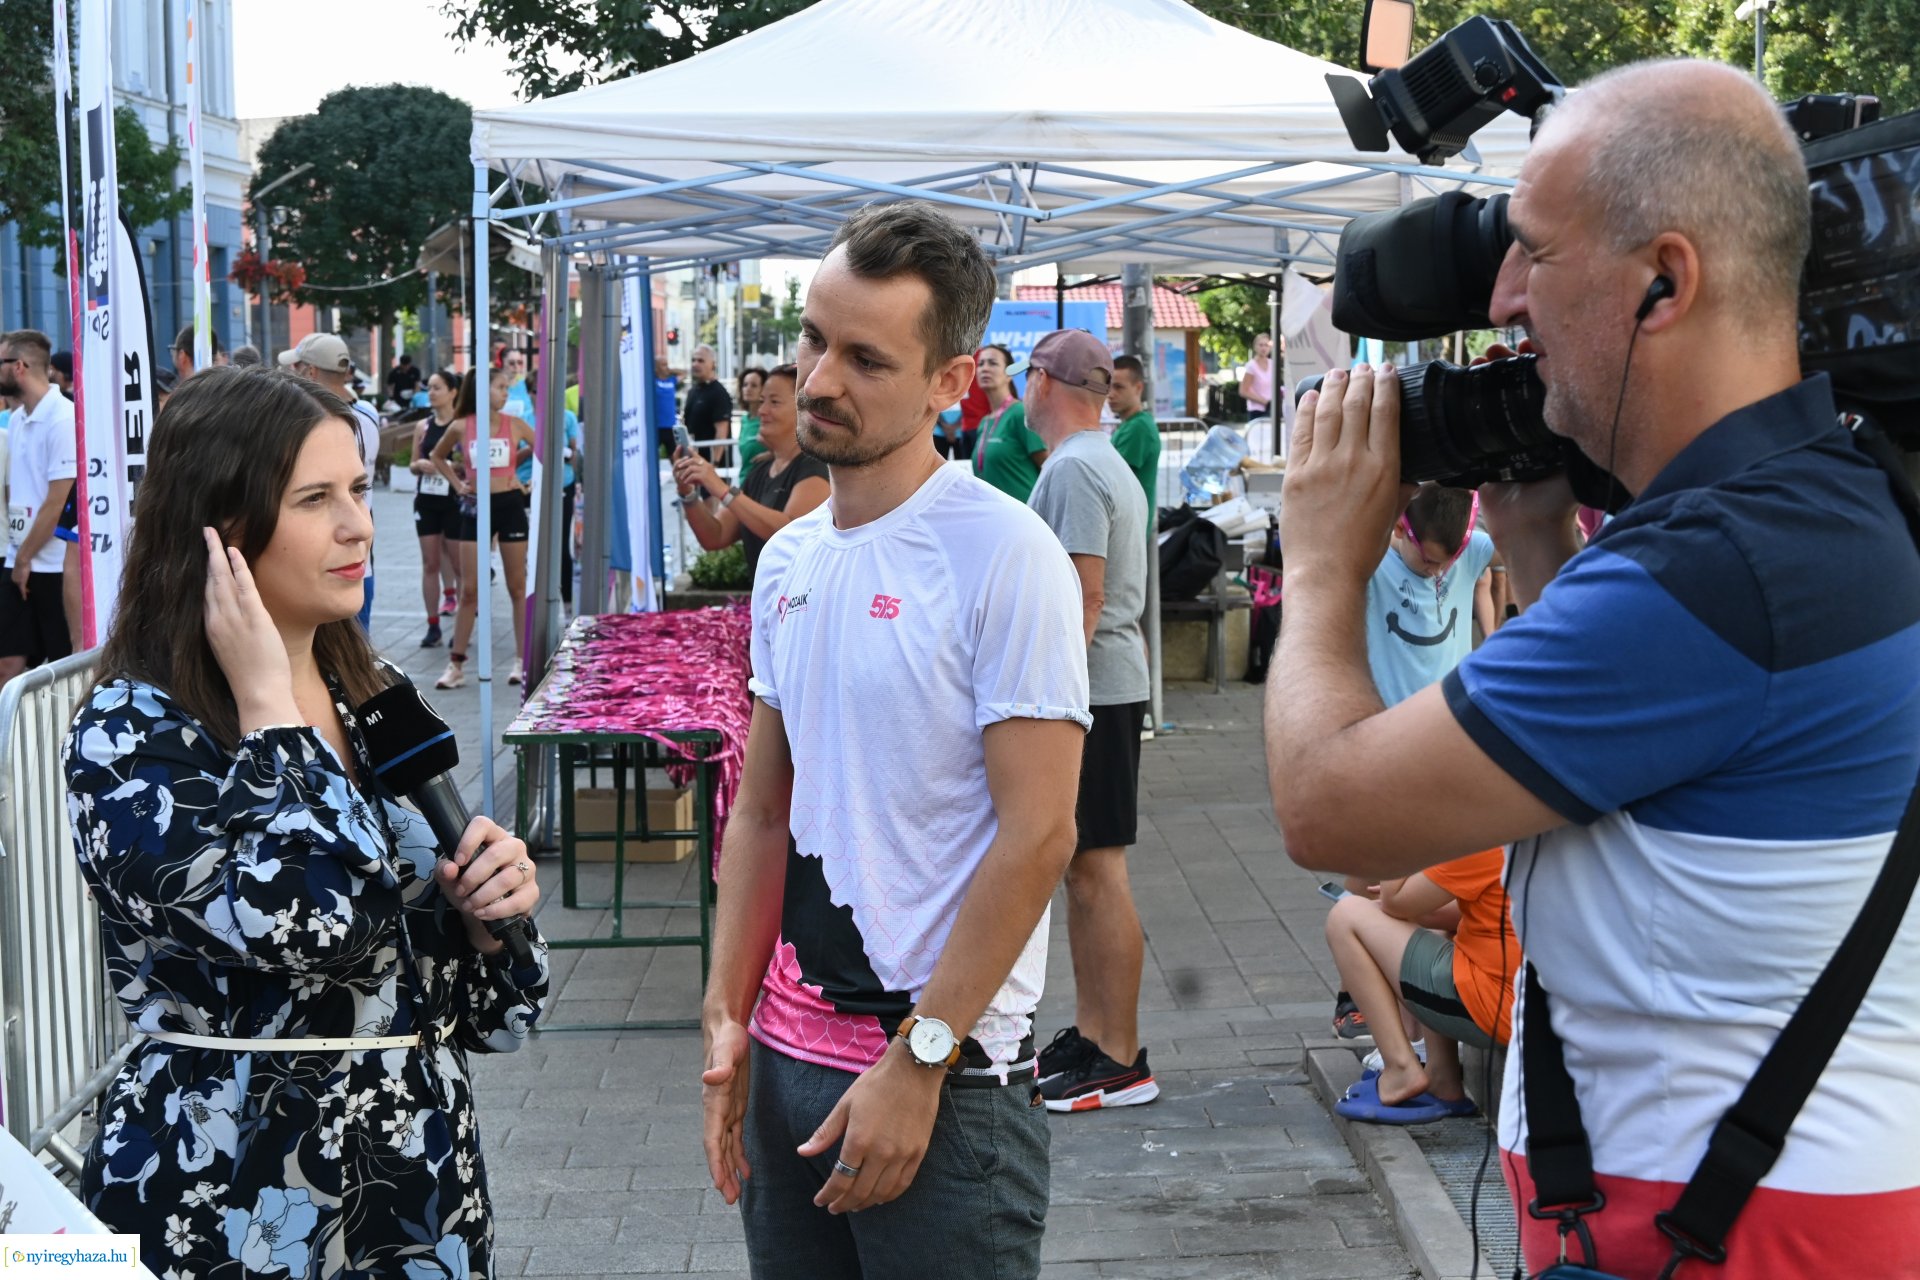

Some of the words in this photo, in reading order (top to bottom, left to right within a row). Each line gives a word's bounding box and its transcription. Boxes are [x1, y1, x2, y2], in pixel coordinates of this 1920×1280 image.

[9, 518, 25, 531] 40
[787, 593, 809, 609] MOZAIK
[365, 709, 383, 726] M1
